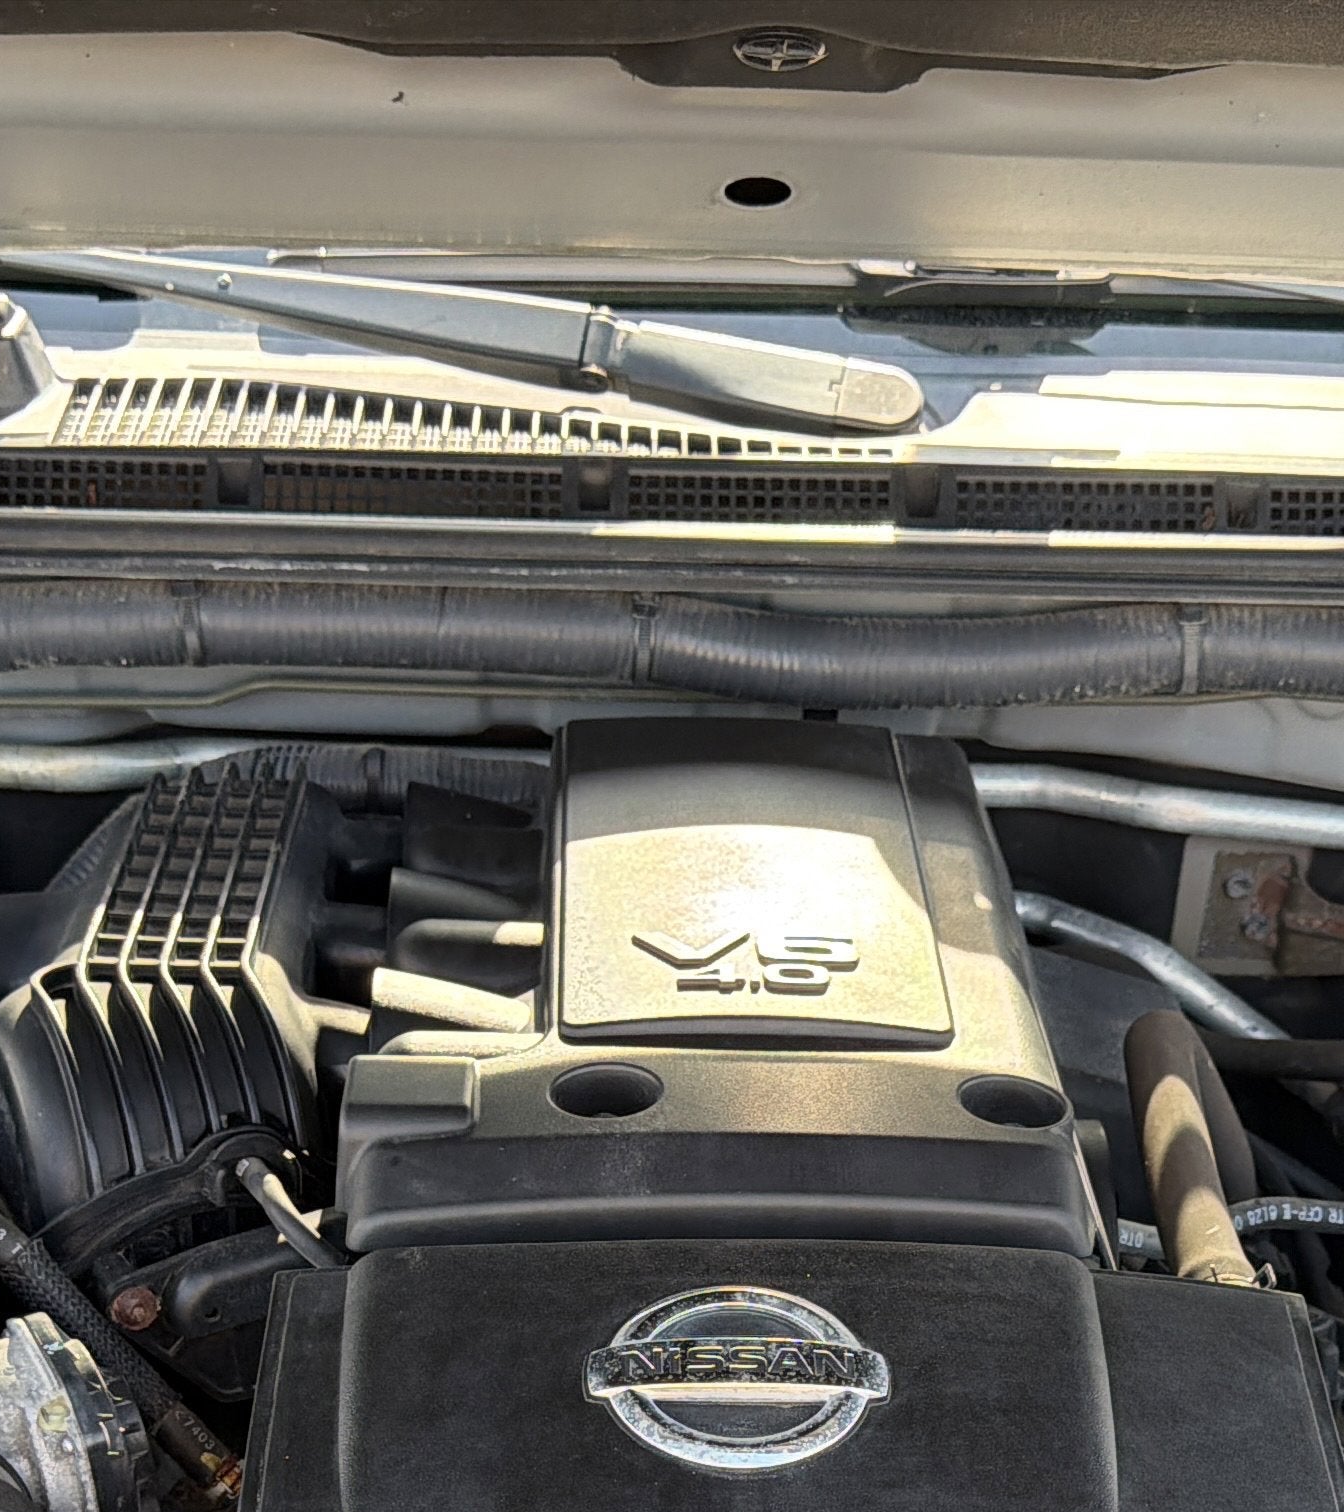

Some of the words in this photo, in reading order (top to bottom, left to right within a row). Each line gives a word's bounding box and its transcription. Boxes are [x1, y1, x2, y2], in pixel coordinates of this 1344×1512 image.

[631, 929, 860, 972] V6
[676, 963, 831, 996] 4.0
[622, 1345, 856, 1380] NISSAN
